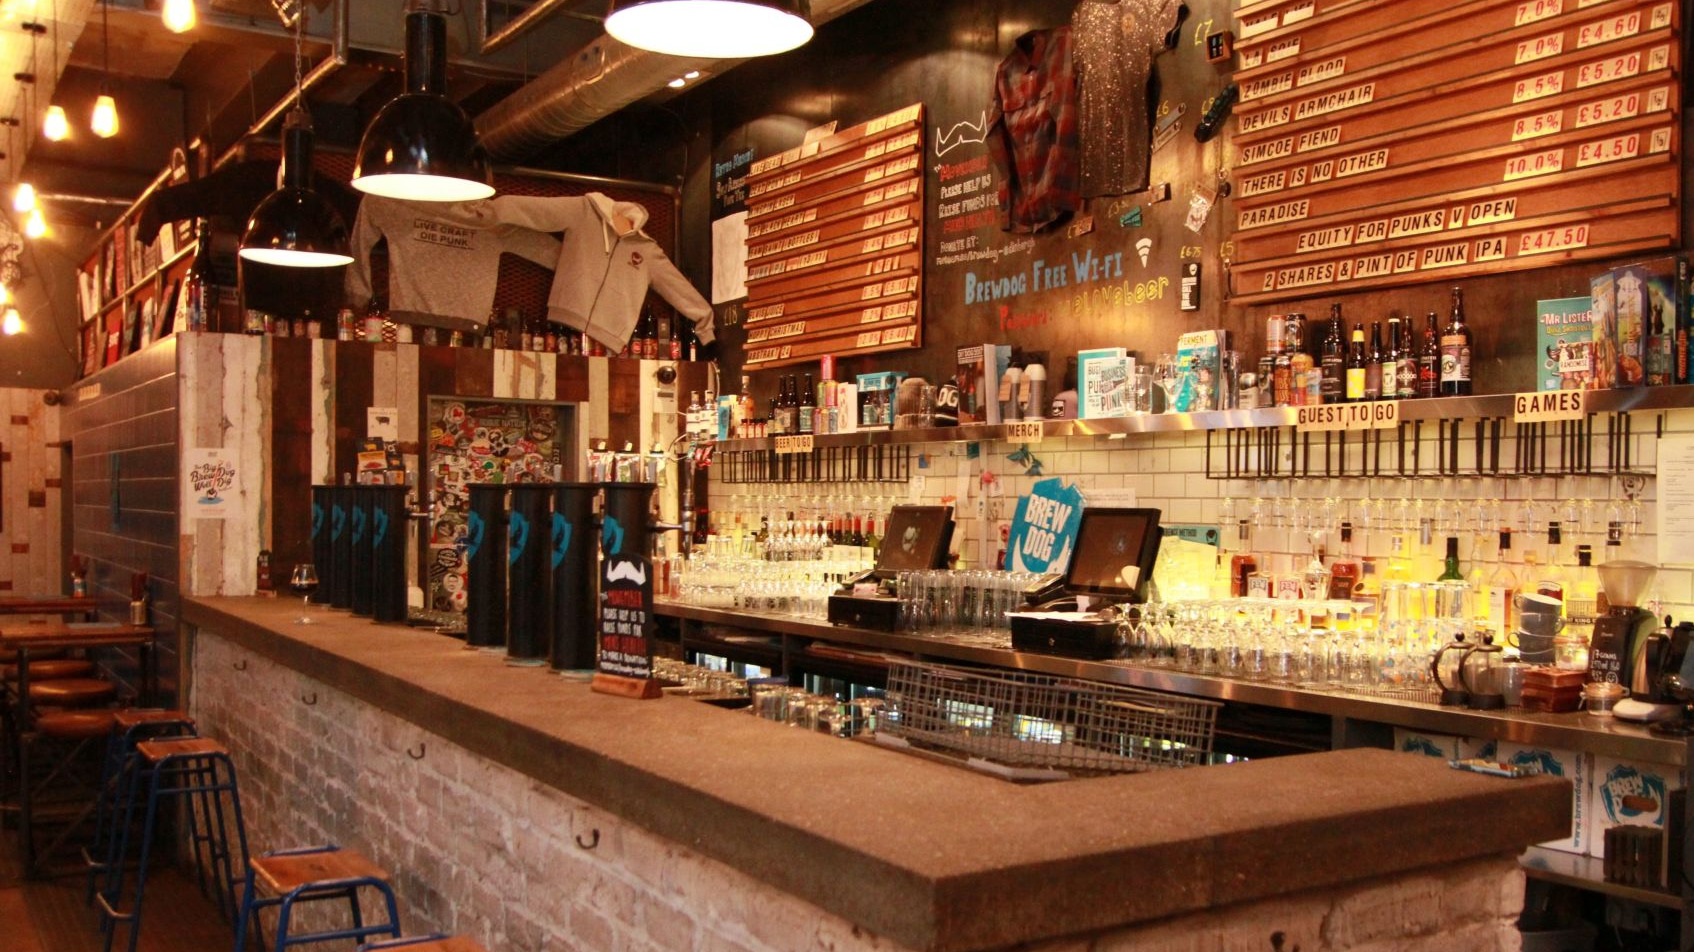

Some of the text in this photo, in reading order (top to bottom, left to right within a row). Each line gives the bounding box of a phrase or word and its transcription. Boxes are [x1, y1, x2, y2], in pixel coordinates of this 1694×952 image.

[1243, 72, 1292, 98] ZOMBIE
[1299, 59, 1344, 84] BLOOD
[1518, 36, 1560, 60] 7.0%
[1581, 14, 1638, 44] £4.60
[1243, 106, 1290, 131] DEVILS
[1298, 84, 1372, 118] ARMCHAIR
[1515, 74, 1560, 99] 8.5%
[1580, 54, 1638, 82] £5.20
[1242, 139, 1292, 163] SIMCOE
[1299, 127, 1340, 149] FIEND
[1515, 113, 1559, 137] 8.5%
[1579, 95, 1637, 123] £5.20
[1241, 201, 1308, 227] PARADISE
[1507, 151, 1560, 176] 10.0%
[1579, 134, 1638, 161] £4.50
[1243, 150, 1386, 194] THERE IS NO OTHER
[439, 235, 469, 247] PUNK
[1299, 199, 1515, 249] EQUITY FOR PUNKS V OPEN
[965, 249, 1123, 305] BREWDOG FREE WI-FI
[1265, 226, 1586, 288] 2 SHARES & PINT OF PUNK IPA £47.50
[1298, 402, 1395, 424] GUEST TO GO
[1517, 392, 1581, 414] GAMES
[775, 435, 811, 449] BEER TO GO
[1008, 423, 1040, 438] MERCH
[1025, 494, 1072, 534] BREW
[1023, 526, 1055, 562] DOG
[1573, 754, 1583, 848] www.brewdog.com
